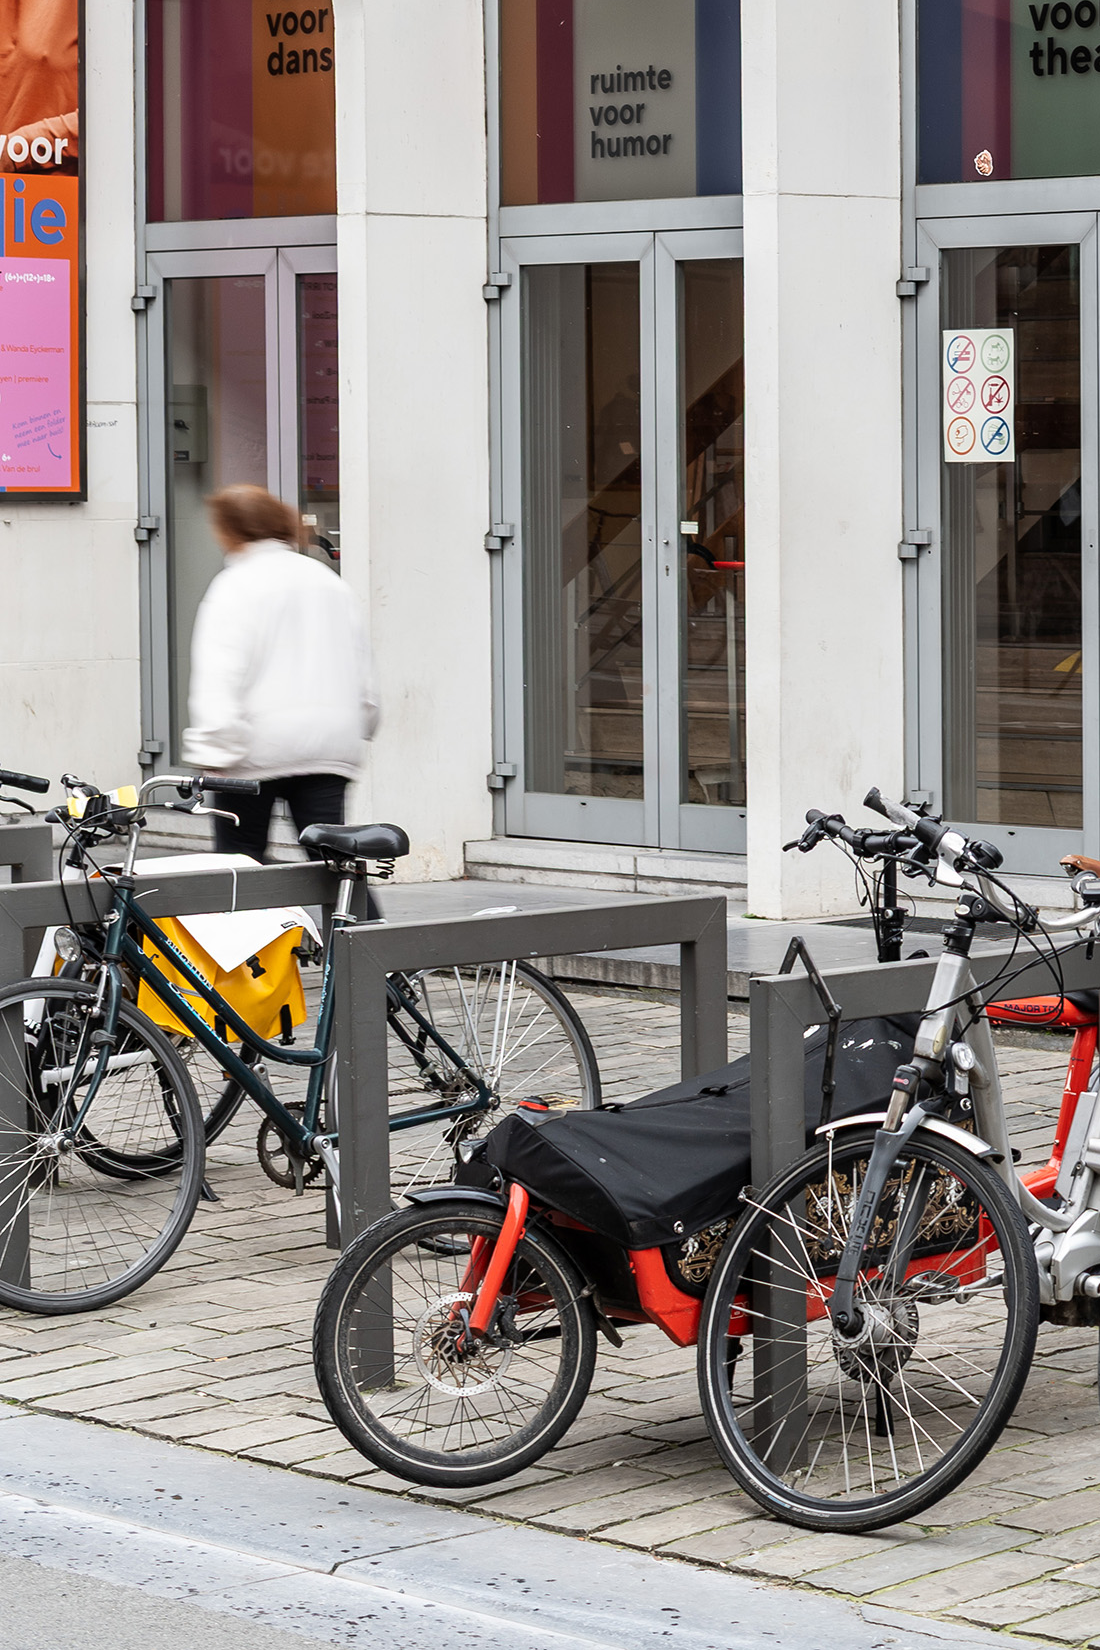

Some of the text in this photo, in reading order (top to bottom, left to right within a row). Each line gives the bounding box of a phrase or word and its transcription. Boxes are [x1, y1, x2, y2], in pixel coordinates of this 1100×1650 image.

[266, 8, 329, 37] voor
[267, 42, 333, 76] dans
[590, 64, 672, 95] ruimte
[589, 102, 646, 127] voor
[590, 130, 673, 159] humor
[1004, 1003, 1042, 1013] MAJOR
